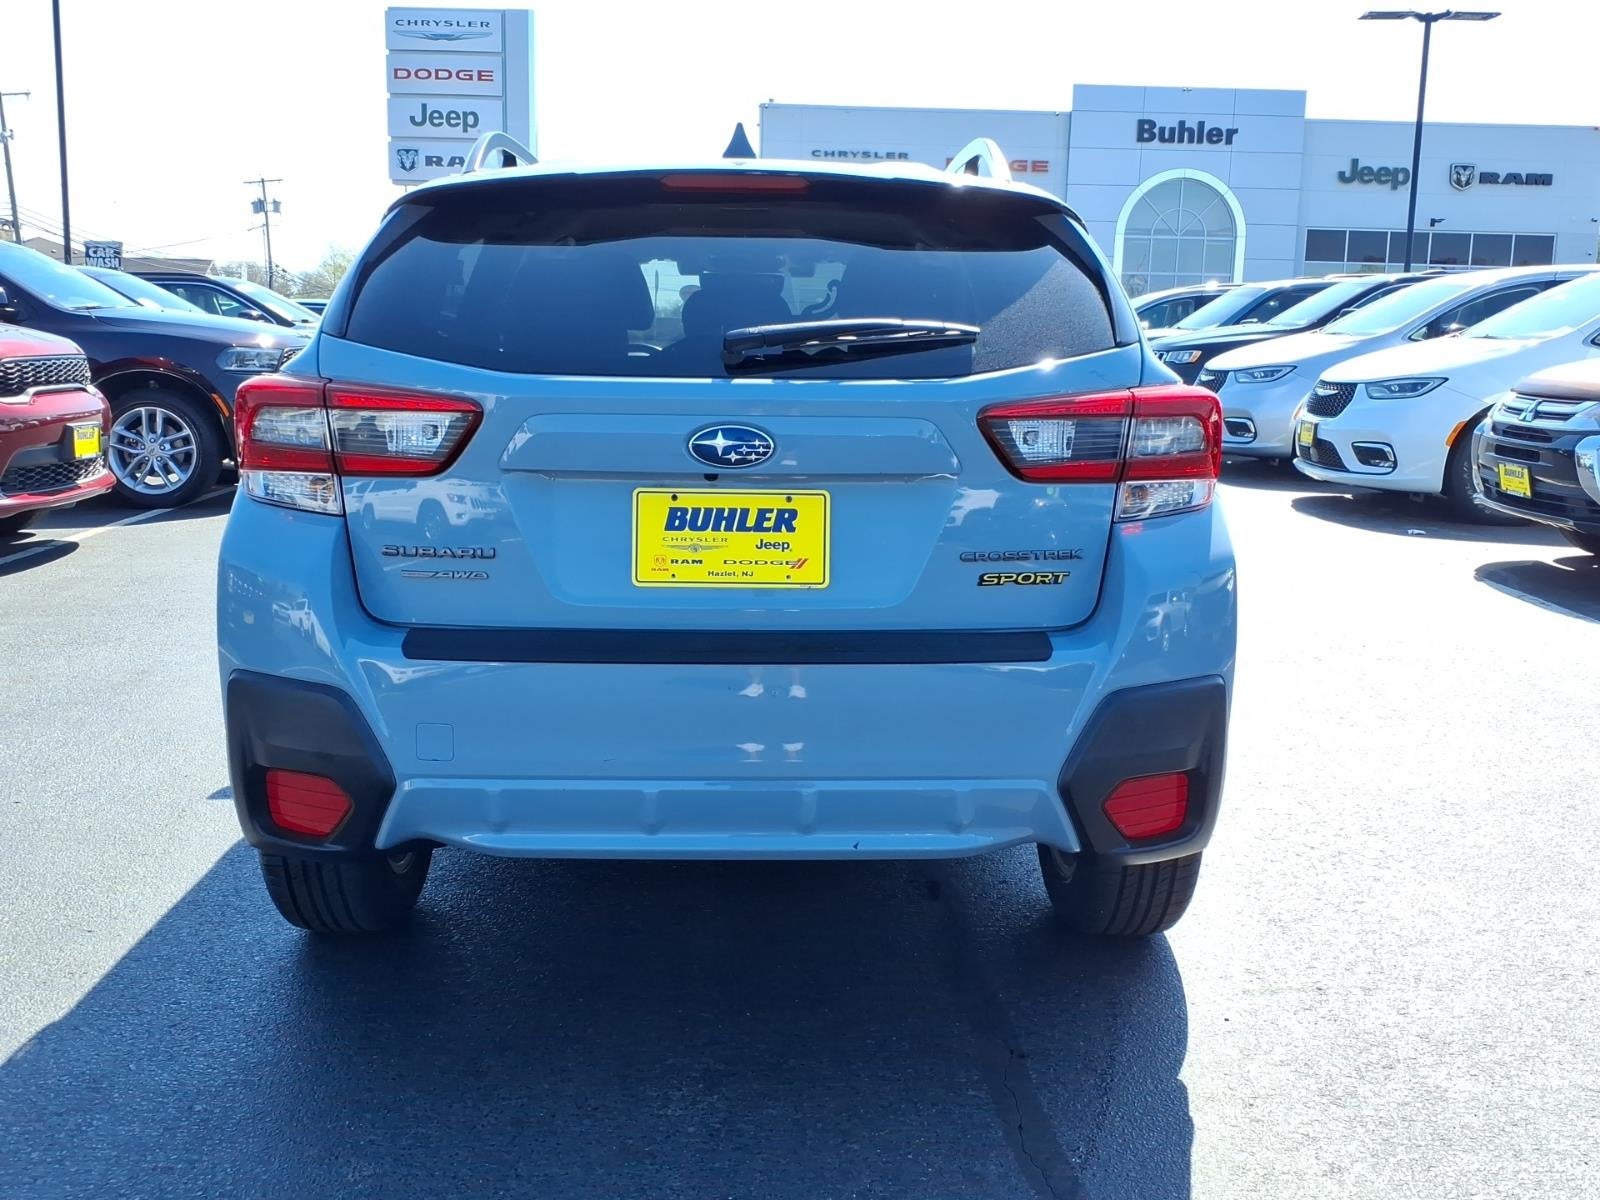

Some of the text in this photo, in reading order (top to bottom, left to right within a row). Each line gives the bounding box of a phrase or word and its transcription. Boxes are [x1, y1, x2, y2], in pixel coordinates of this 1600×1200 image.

[395, 19, 491, 28] CHRYSLER
[393, 68, 494, 82] DODGE
[409, 103, 480, 133] Jeep
[1136, 118, 1239, 145] Buhler
[424, 155, 466, 167] RA
[811, 149, 909, 160] CHRYSLER
[1337, 158, 1410, 190] Jeep
[1478, 171, 1553, 186] RAM
[88, 247, 115, 258] CAR
[86, 257, 120, 268] WASH
[664, 506, 798, 533] BUHLER
[381, 544, 496, 559] SUBARU
[755, 538, 791, 552] Jeep
[959, 549, 1084, 563] CROSSTREK
[433, 570, 490, 580] AWD
[707, 570, 739, 578] Hazlet,
[978, 571, 1070, 586] SPORT
